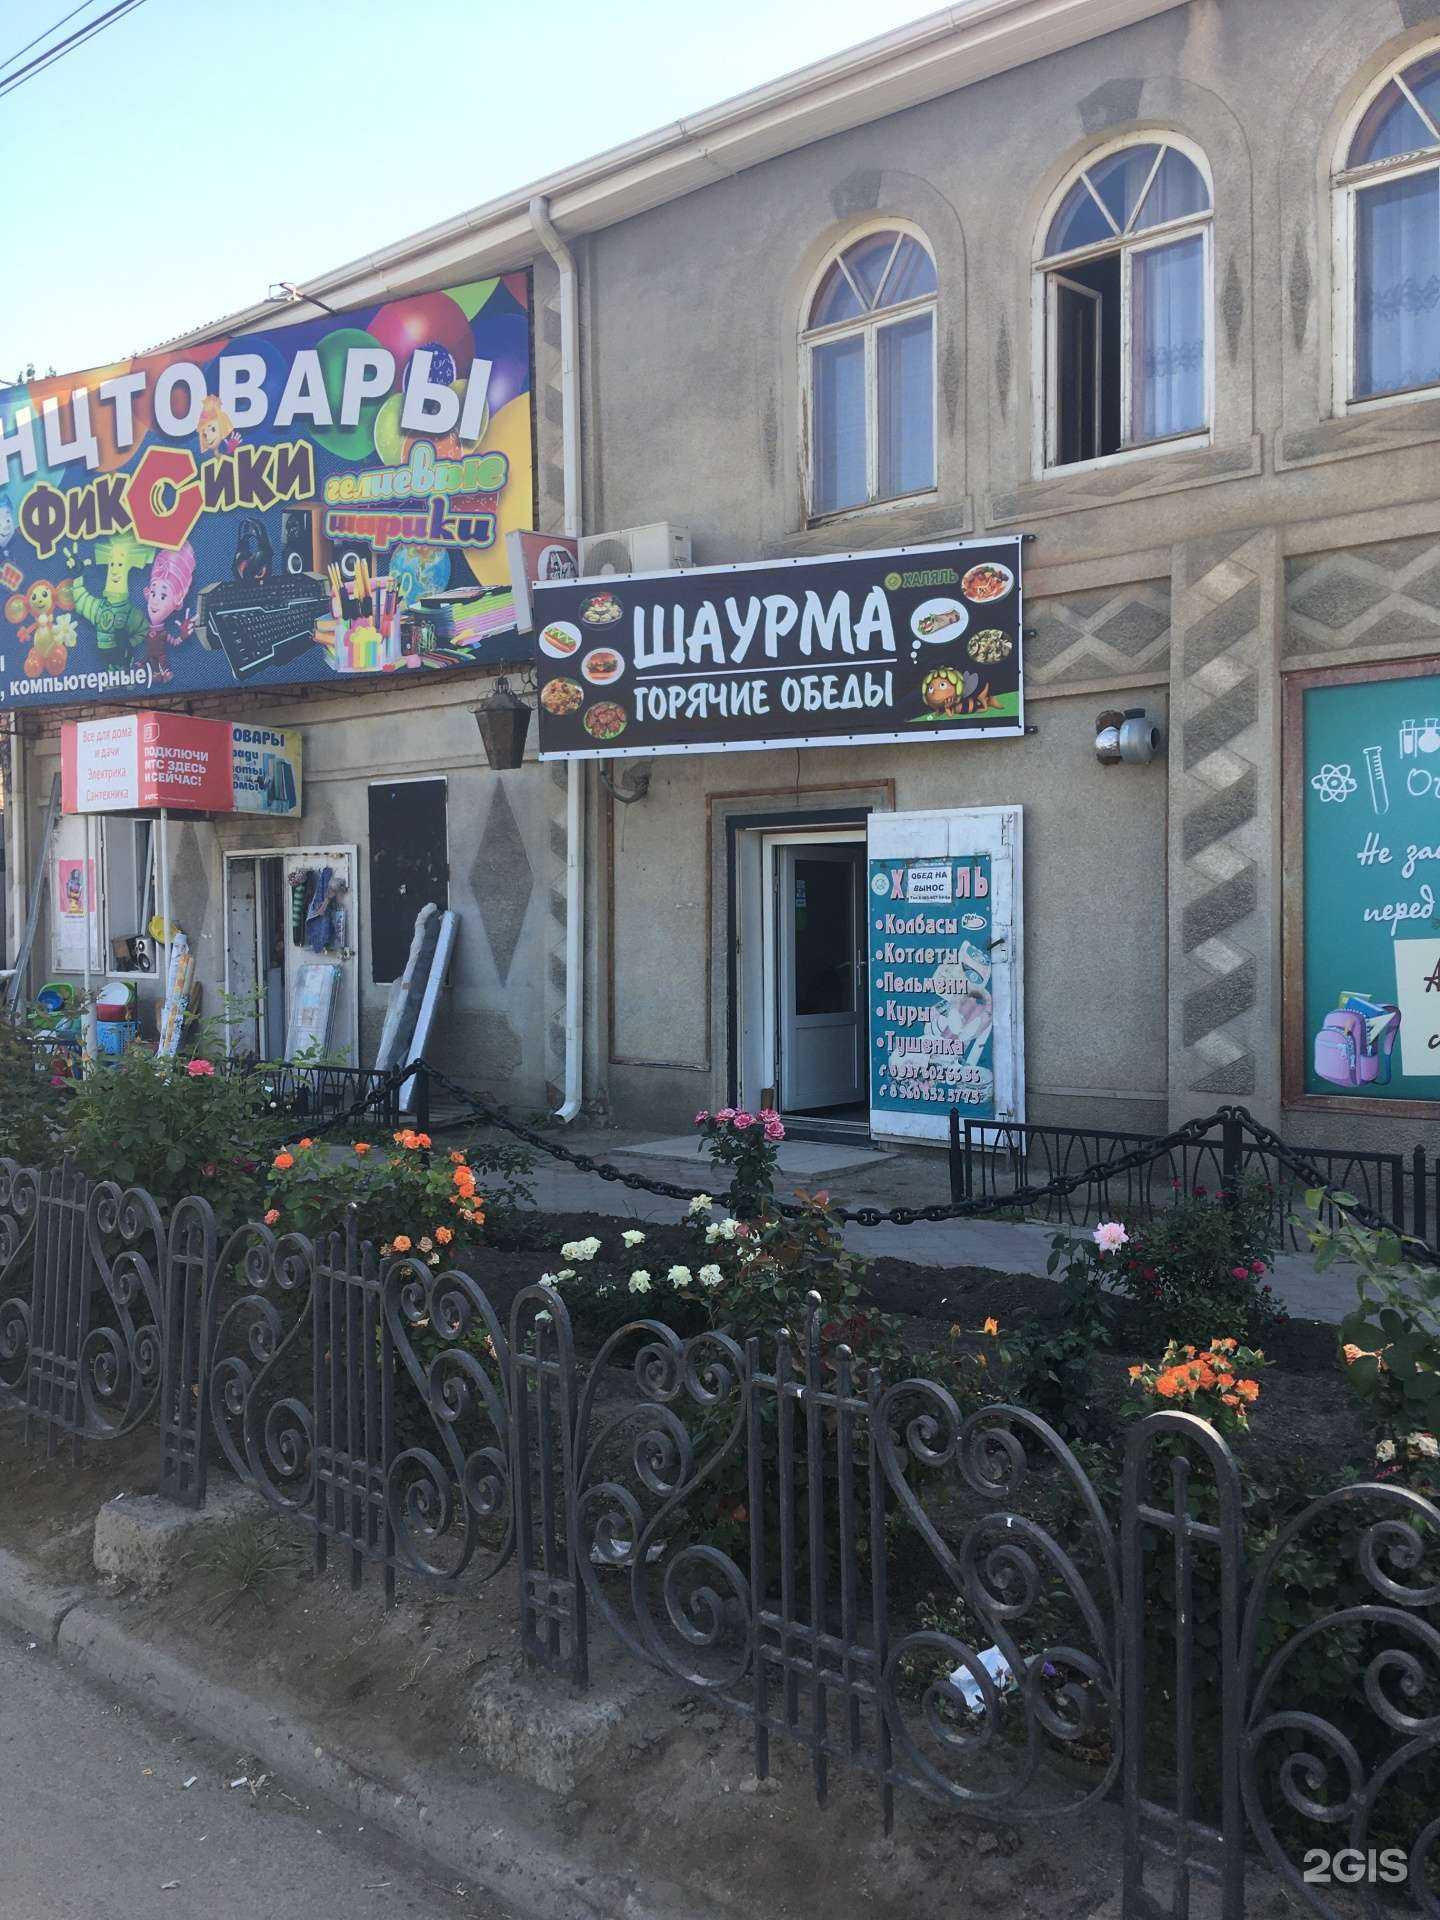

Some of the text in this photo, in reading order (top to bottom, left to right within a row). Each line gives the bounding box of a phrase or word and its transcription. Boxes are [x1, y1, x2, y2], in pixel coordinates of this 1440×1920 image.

[901, 568, 959, 588] ХАЛЯЛЬ
[633, 586, 897, 669] ШАУРМА
[633, 670, 893, 722] ГОРЯЧИЕ ОБЕДЫ
[144, 746, 209, 762] ПОДКЛЮЧИ
[144, 759, 207, 774] МТС ЗДЕСЬ
[151, 771, 202, 786] СЕЙЧАС!
[1357, 832, 1393, 866] Не
[911, 871, 948, 880] ОБЕД НА
[913, 884, 945, 892] ВЫНОС
[1363, 884, 1435, 936] перед
[885, 913, 958, 935] Колбасы
[884, 943, 960, 964] Котлеты
[884, 971, 969, 994] Пельмени
[886, 1000, 931, 1027] Куры
[885, 1031, 965, 1057] Тушенка
